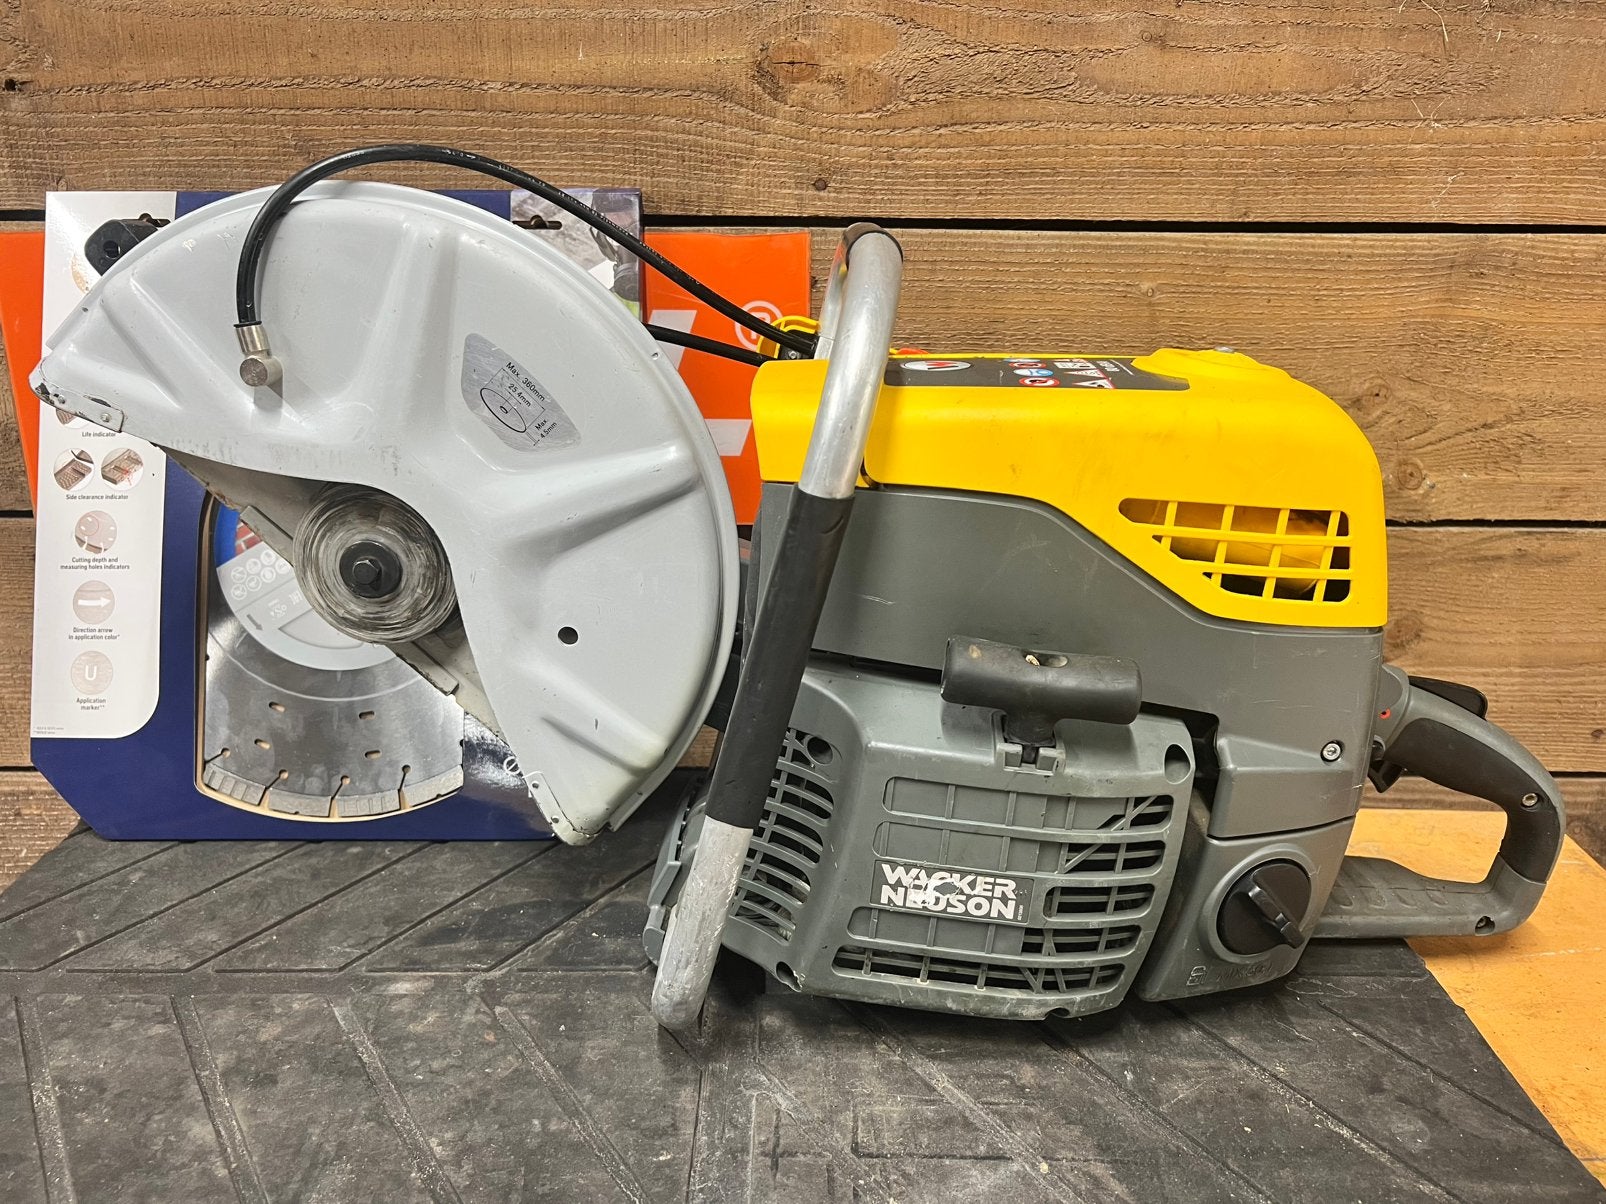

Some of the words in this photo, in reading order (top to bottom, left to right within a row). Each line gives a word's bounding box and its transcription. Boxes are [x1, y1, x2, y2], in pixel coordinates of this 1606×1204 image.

[521, 377, 546, 402] 360mm
[881, 863, 1017, 900] WACKER
[880, 884, 1016, 920] NEUSON
